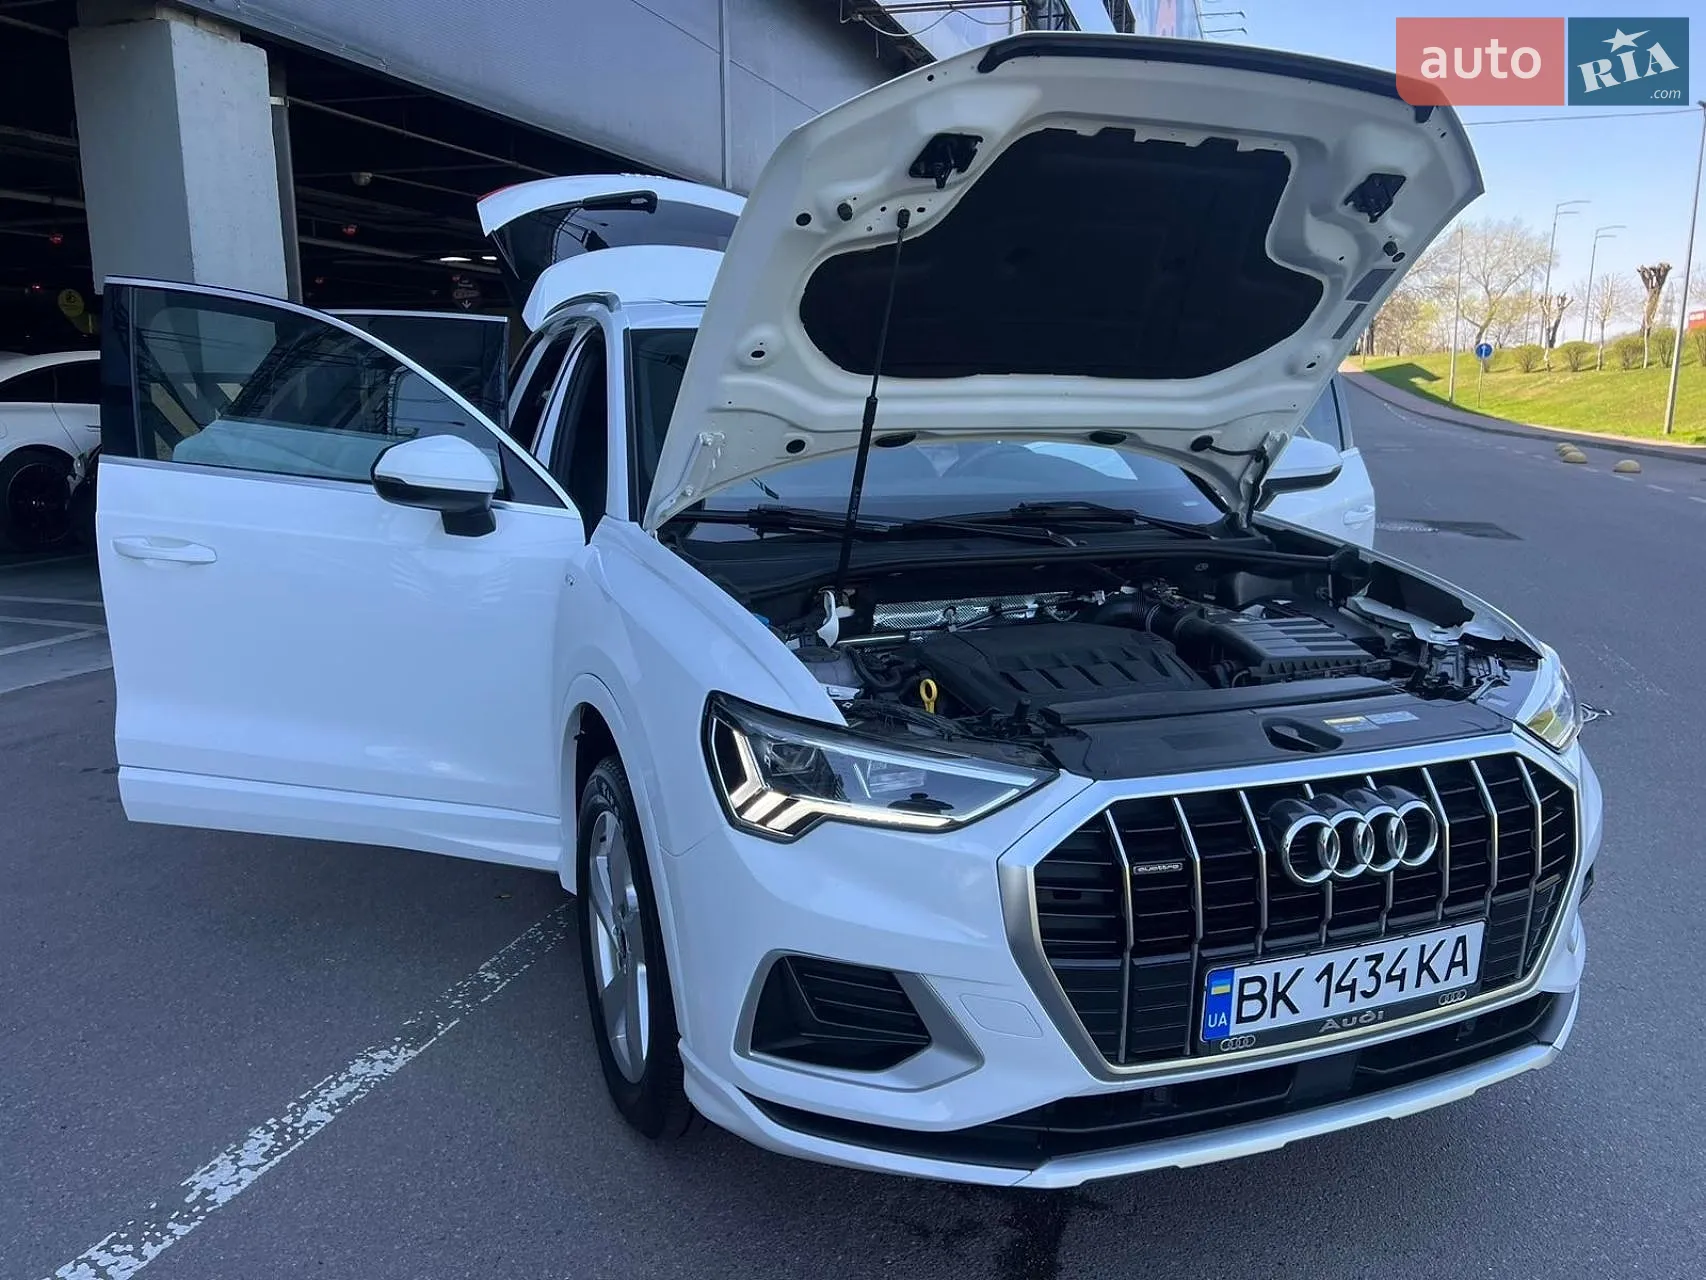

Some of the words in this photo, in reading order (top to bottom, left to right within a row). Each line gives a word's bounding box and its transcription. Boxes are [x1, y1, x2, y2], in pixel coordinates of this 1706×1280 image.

[1235, 967, 1304, 1025] BK
[1315, 948, 1408, 1008] 1434
[1207, 1012, 1228, 1029] UA
[1319, 1011, 1385, 1033] Audi
